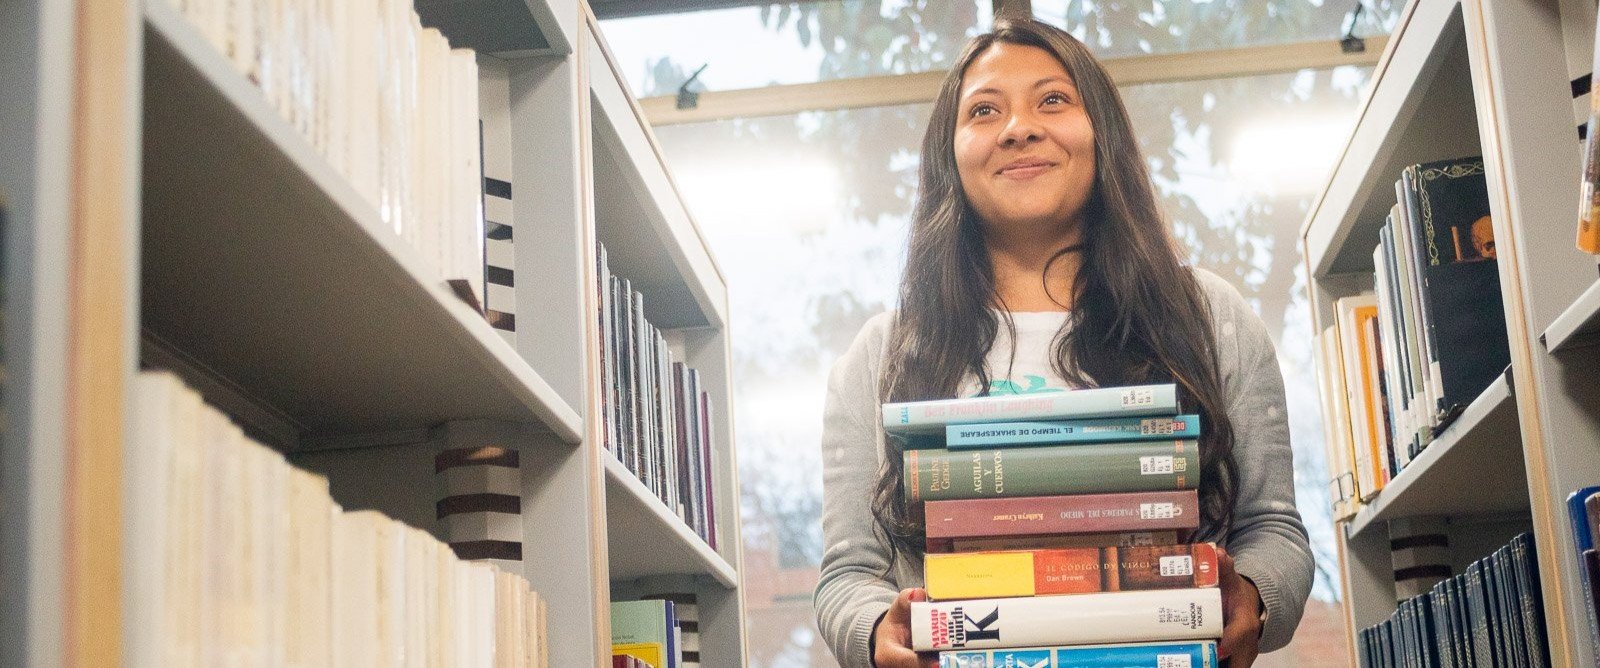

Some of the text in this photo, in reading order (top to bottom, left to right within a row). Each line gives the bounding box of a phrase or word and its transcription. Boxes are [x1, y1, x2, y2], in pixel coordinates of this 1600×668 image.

[960, 428, 1016, 438] SHAKESPEARE
[1018, 428, 1029, 436] DE
[1031, 427, 1062, 436] TIEMPO
[994, 451, 1004, 494] CUERVOS
[1060, 510, 1084, 519] MIEDO
[931, 608, 939, 648] MARIO
[940, 612, 948, 645] PUZO
[964, 606, 1000, 643] K
